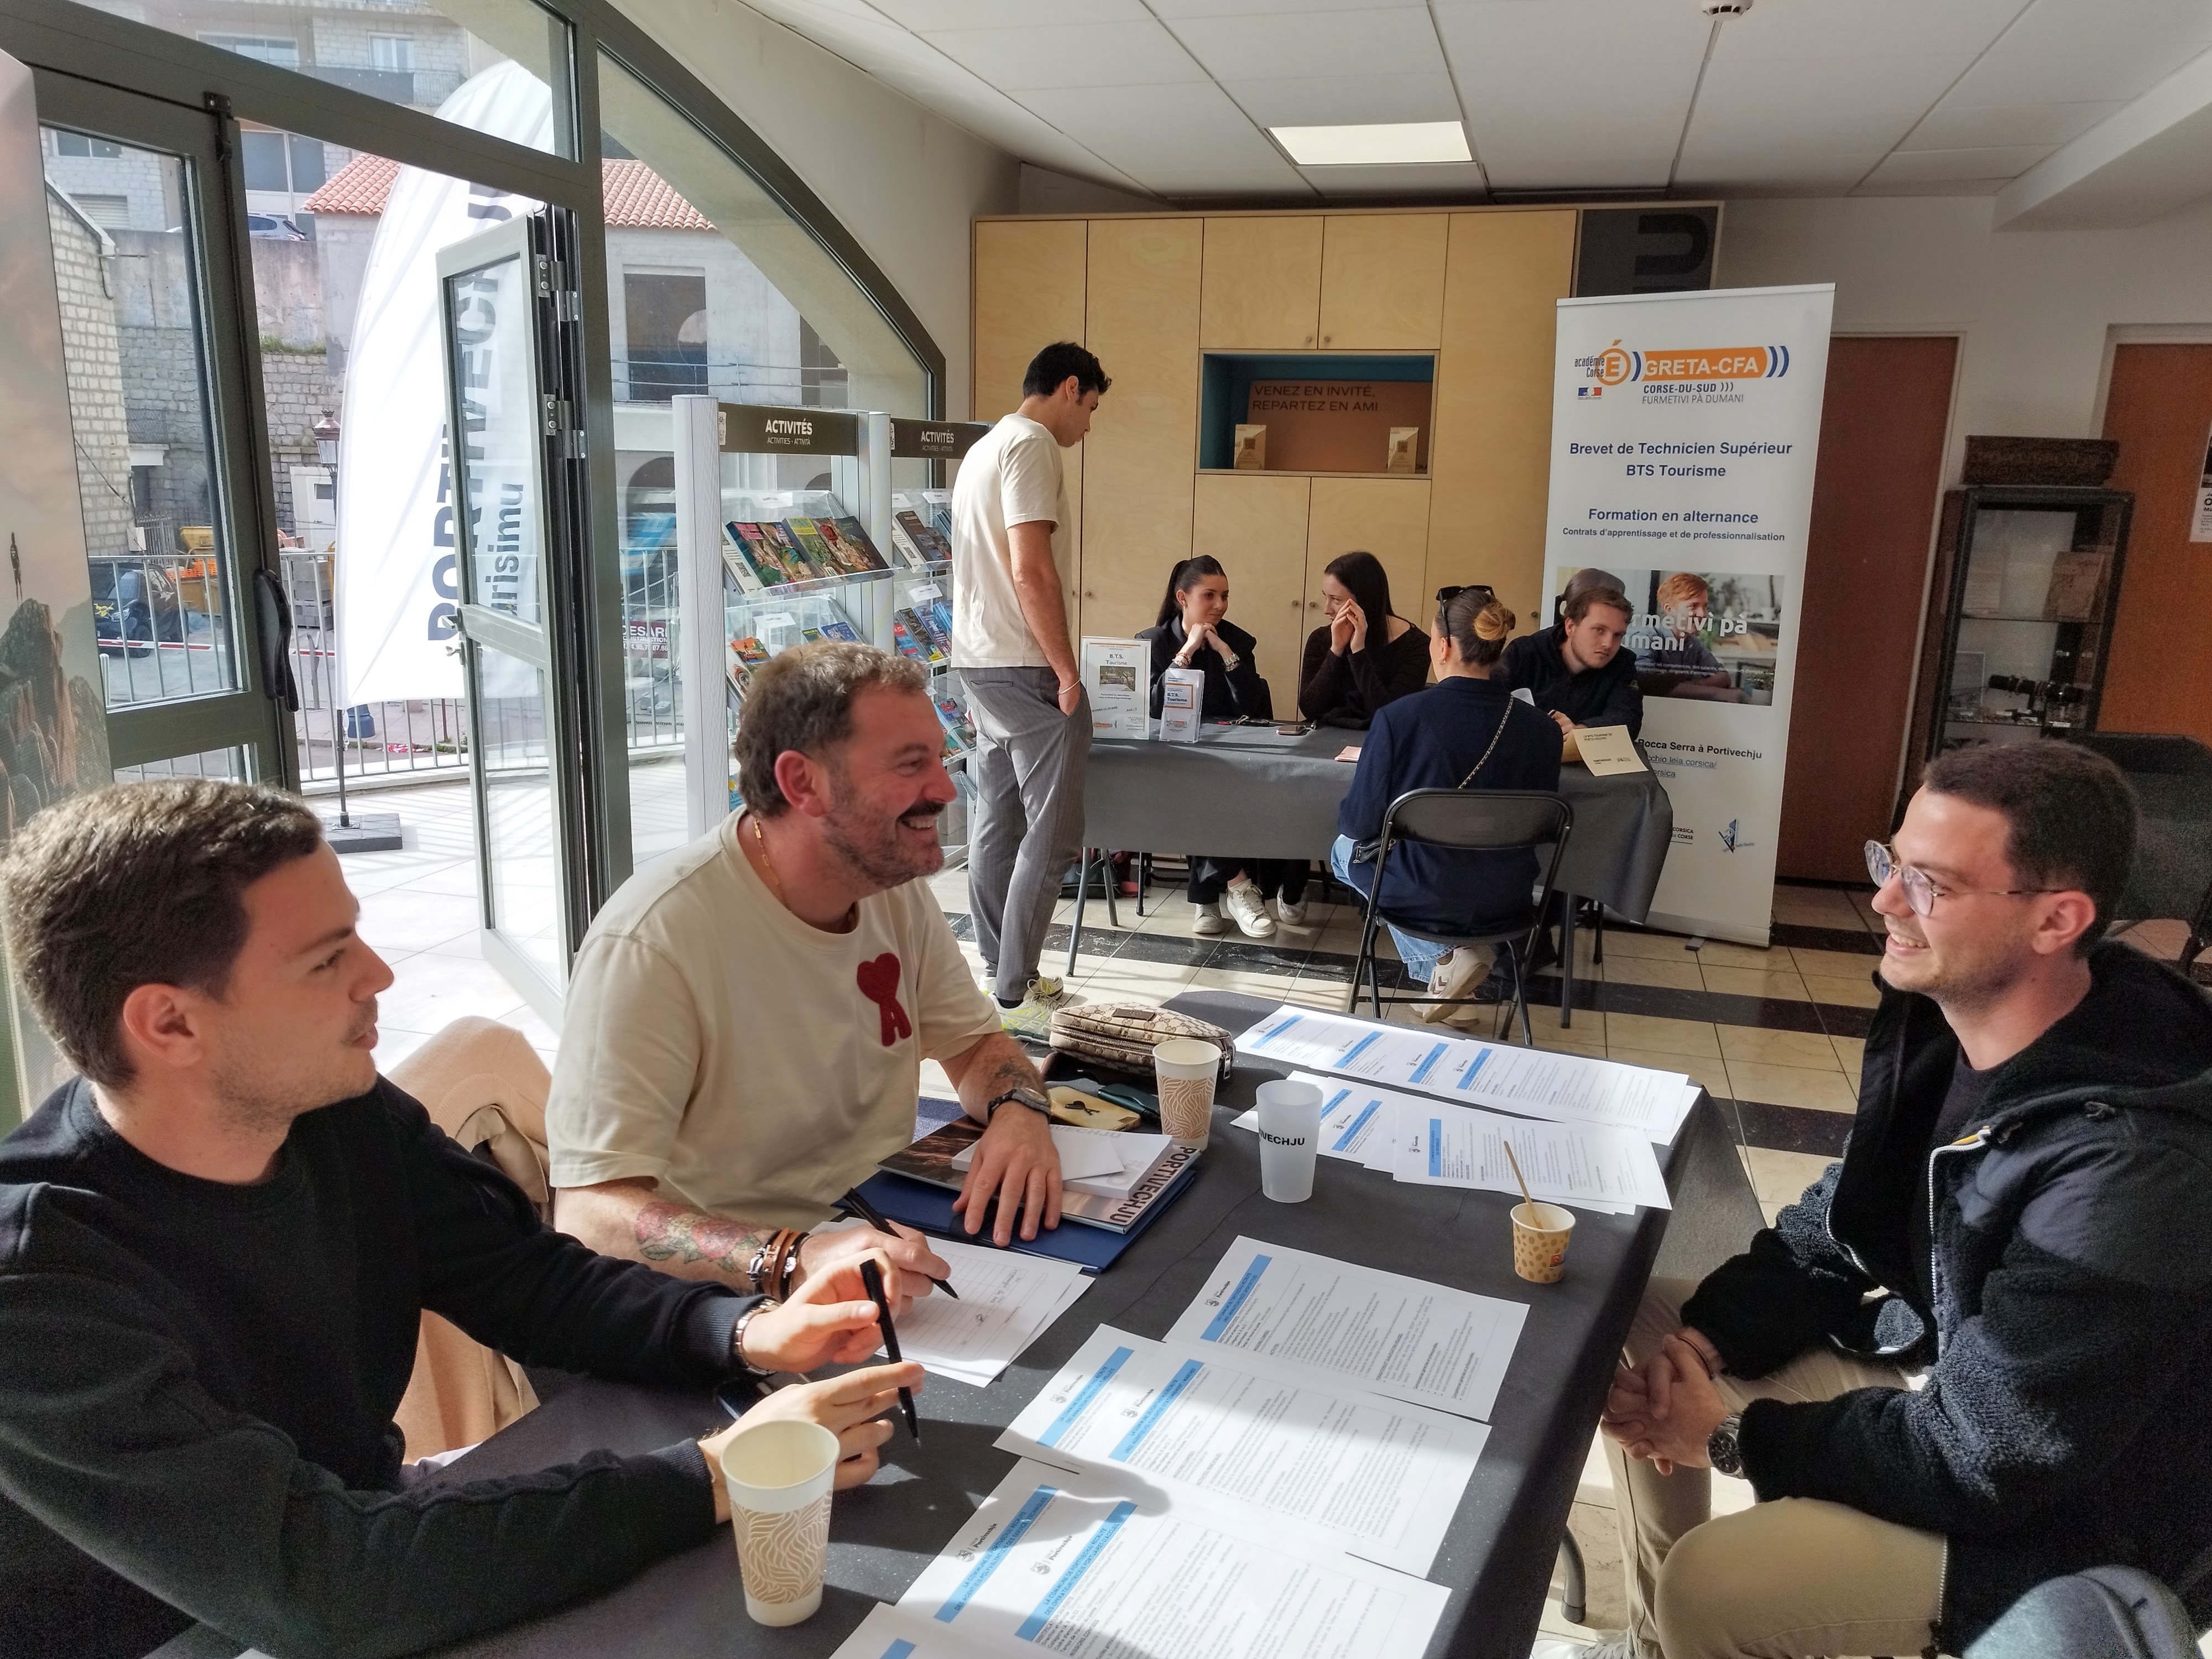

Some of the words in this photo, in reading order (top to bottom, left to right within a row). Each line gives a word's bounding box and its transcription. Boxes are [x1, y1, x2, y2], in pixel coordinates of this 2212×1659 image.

[1574, 356, 1605, 367] académie
[1644, 356, 1759, 377] GRETA-CFA
[1586, 367, 1604, 378] Corse
[1255, 386, 1300, 396] VENEZ
[1304, 386, 1322, 396] EN
[1327, 384, 1375, 398] INVITÉ,
[1644, 383, 1717, 394] CORSE-DU-SUD
[1642, 395, 1689, 404] FURMETIVI
[1705, 394, 1744, 403] DUMANI
[1253, 401, 1326, 411] REPARTEZ
[1330, 401, 1348, 411] EN
[1353, 401, 1379, 412] AMI
[765, 418, 813, 435] ACTIVITÉS
[921, 429, 954, 444] ACTIVITÉS
[1569, 444, 1613, 455] Brevet
[1617, 444, 1634, 455] de
[1639, 442, 1715, 455] Technicien
[1719, 442, 1793, 457] Supérieur
[1626, 465, 1655, 476] BTS
[1659, 465, 1726, 477] Tourisme
[1588, 508, 1658, 522] Formation
[1662, 511, 1678, 522] en
[1683, 510, 1759, 524] alternance
[1562, 528, 1598, 537] Contrats
[1599, 529, 1667, 540] d'apprentissage
[1680, 530, 1691, 539] de
[1693, 531, 1785, 542] professionnalisation
[1631, 611, 1714, 632] rmetivì
[1670, 742, 1695, 752] Serra
[1698, 744, 1704, 753] à
[1707, 745, 1762, 760] Portivechju
[1109, 1146, 1198, 1223] PORTIVECHJU
